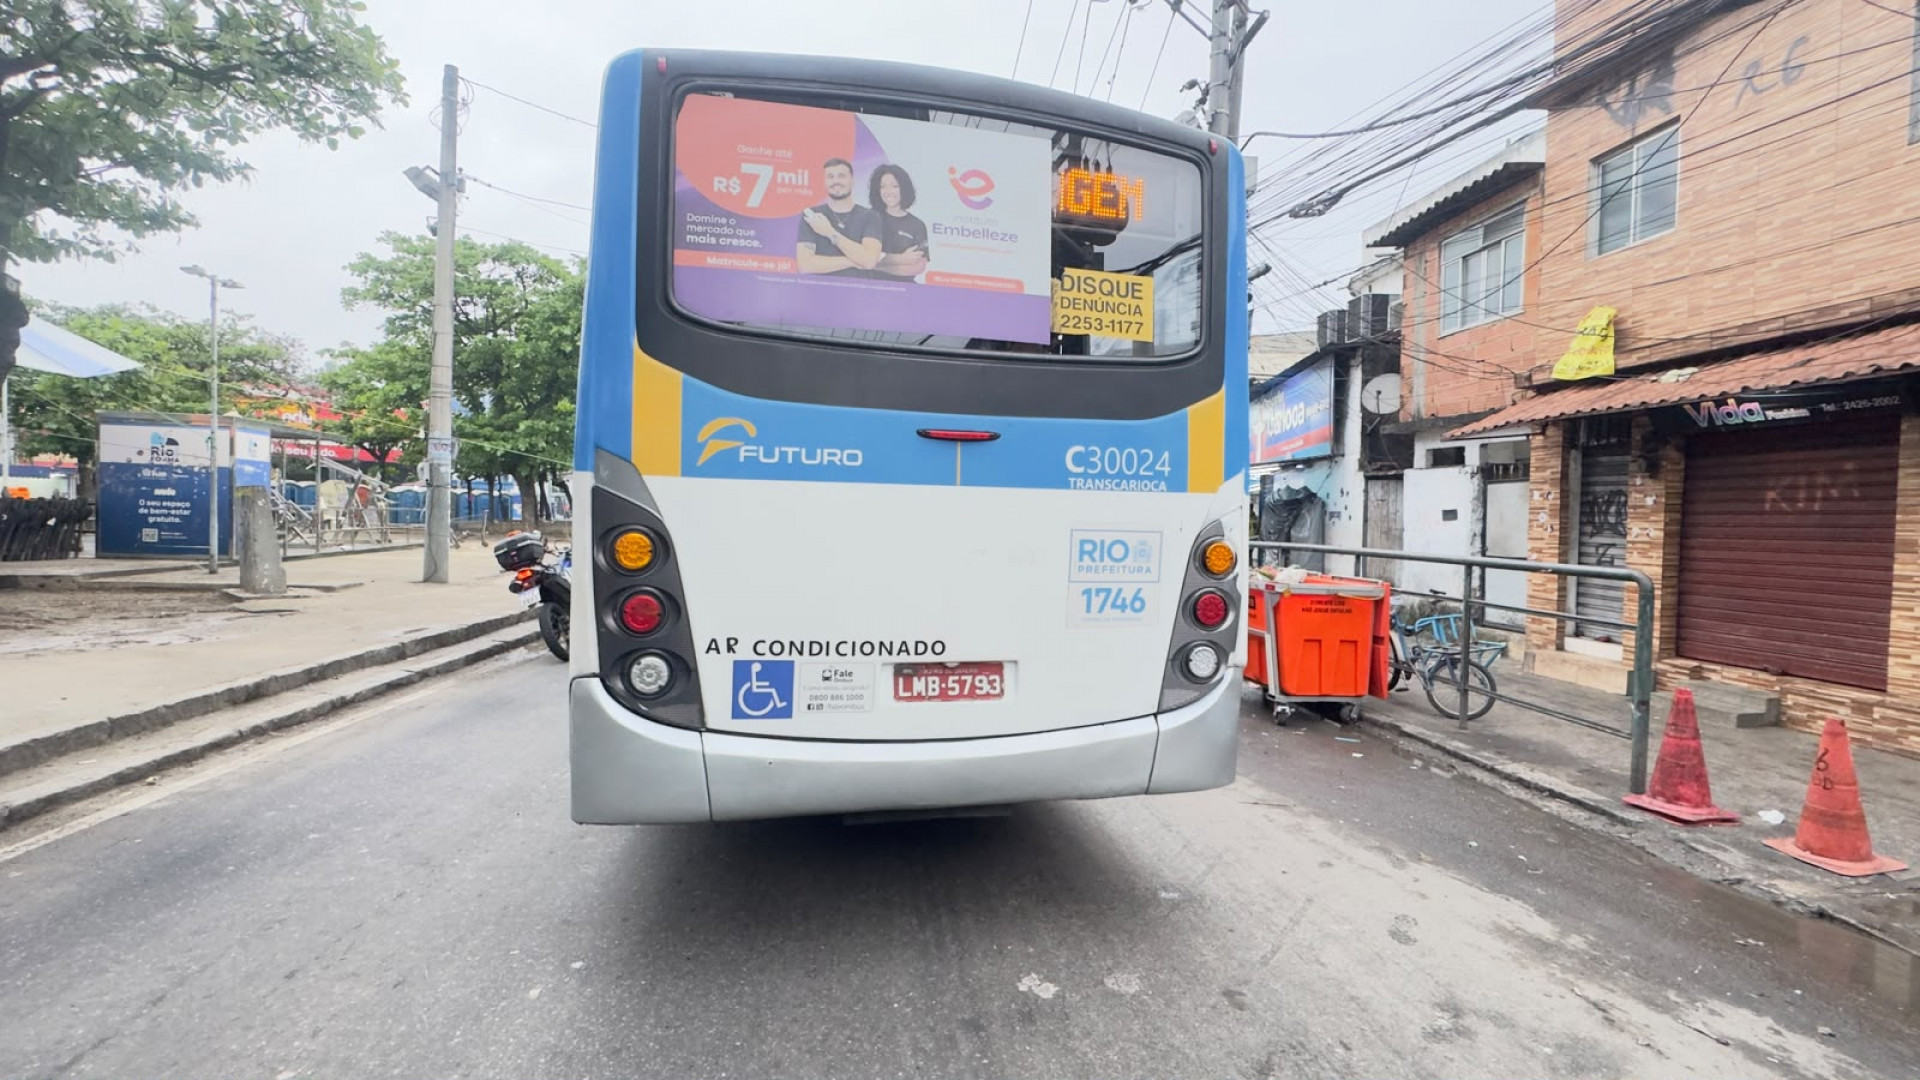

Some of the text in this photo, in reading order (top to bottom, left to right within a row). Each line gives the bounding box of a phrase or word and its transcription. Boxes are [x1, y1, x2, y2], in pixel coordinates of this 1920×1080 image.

[777, 168, 809, 186] mil
[686, 212, 737, 226] Domine o
[686, 223, 756, 238] mercado que
[931, 222, 1019, 244] Embelleze
[686, 233, 763, 248] mais cresce.
[706, 255, 776, 271] Matricule-se
[1060, 274, 1144, 300] DISQUE
[1060, 296, 1144, 317] DENÚNCIA
[1060, 314, 1145, 335] 2253-1177
[1682, 397, 1766, 428] Vida
[150, 444, 175, 457] Rio
[738, 445, 863, 467] FUTURO
[1065, 445, 1171, 477] C30024
[1067, 477, 1168, 492] TRANSCARIOCA
[139, 499, 191, 510] O seu espaço
[150, 508, 191, 516] bem-estar
[148, 516, 182, 524] gratuito.
[1078, 539, 1130, 563] RIO
[1077, 565, 1153, 575] PREFEITURA
[1081, 587, 1146, 614] 1746
[705, 637, 947, 657] AR CONDICIONADO
[834, 669, 854, 678] Fale
[846, 694, 865, 702] 1000
